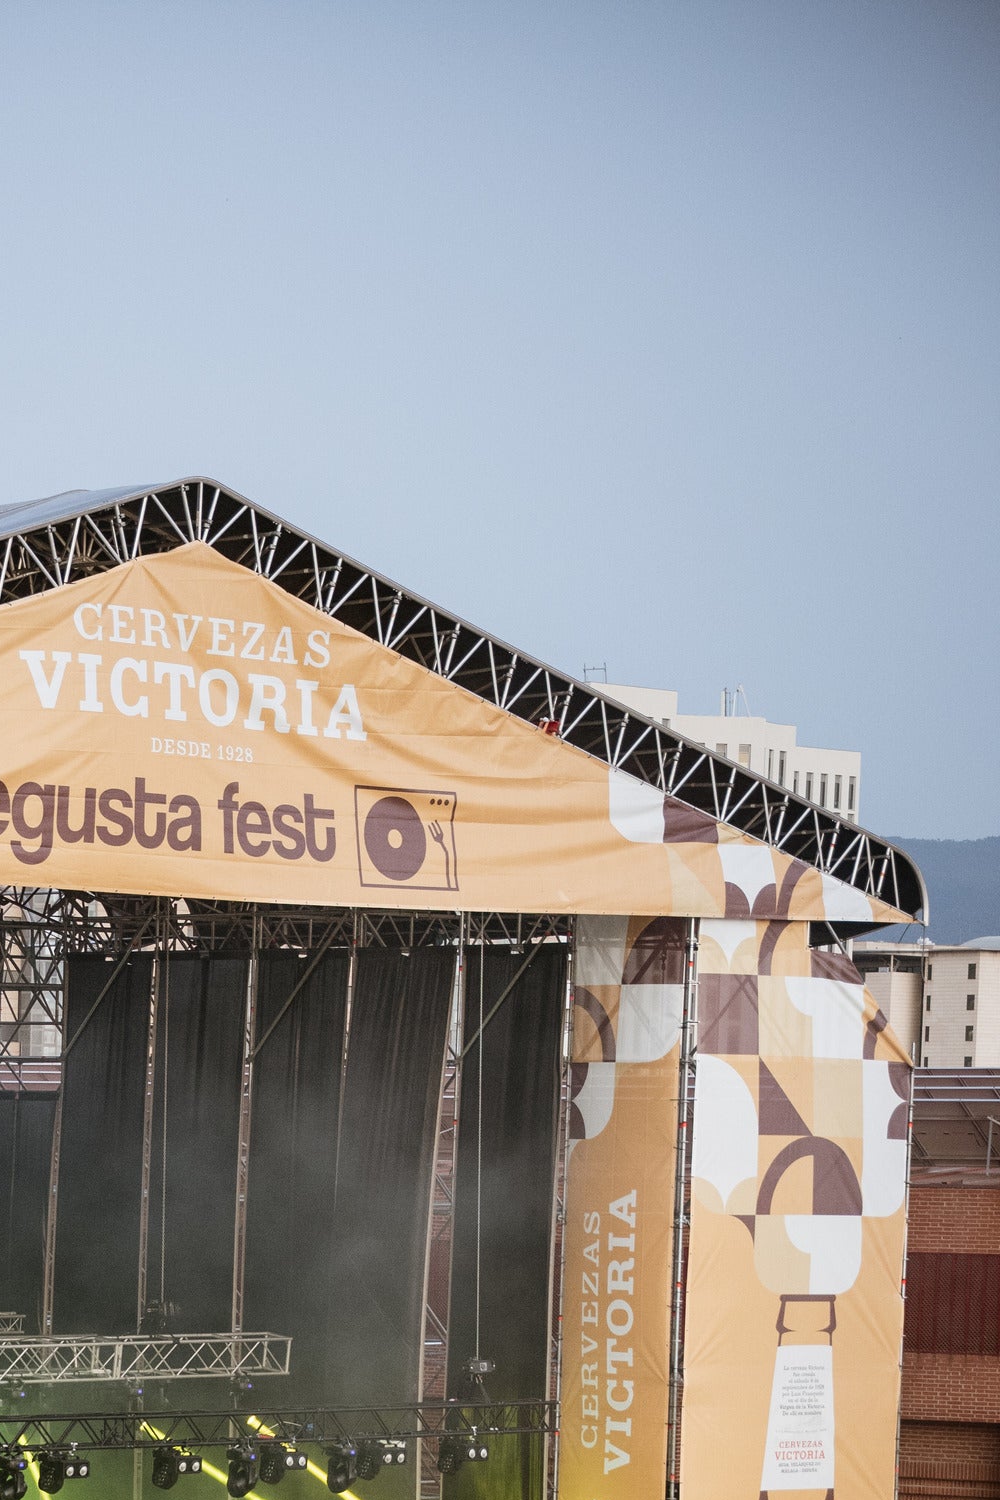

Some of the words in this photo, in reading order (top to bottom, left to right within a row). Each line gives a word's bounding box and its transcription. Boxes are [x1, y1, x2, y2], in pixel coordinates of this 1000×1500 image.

[73, 602, 331, 668] CERVEZAS
[19, 650, 367, 742] VICTORIA
[151, 736, 212, 760] DESDE
[216, 745, 254, 763] 1928
[217, 781, 337, 862] fest
[580, 1210, 601, 1450] CERVEZAS
[603, 1189, 637, 1475] VICTORIA
[775, 1450, 826, 1461] VICTORIA
[779, 1440, 823, 1449] CERVEZAS
